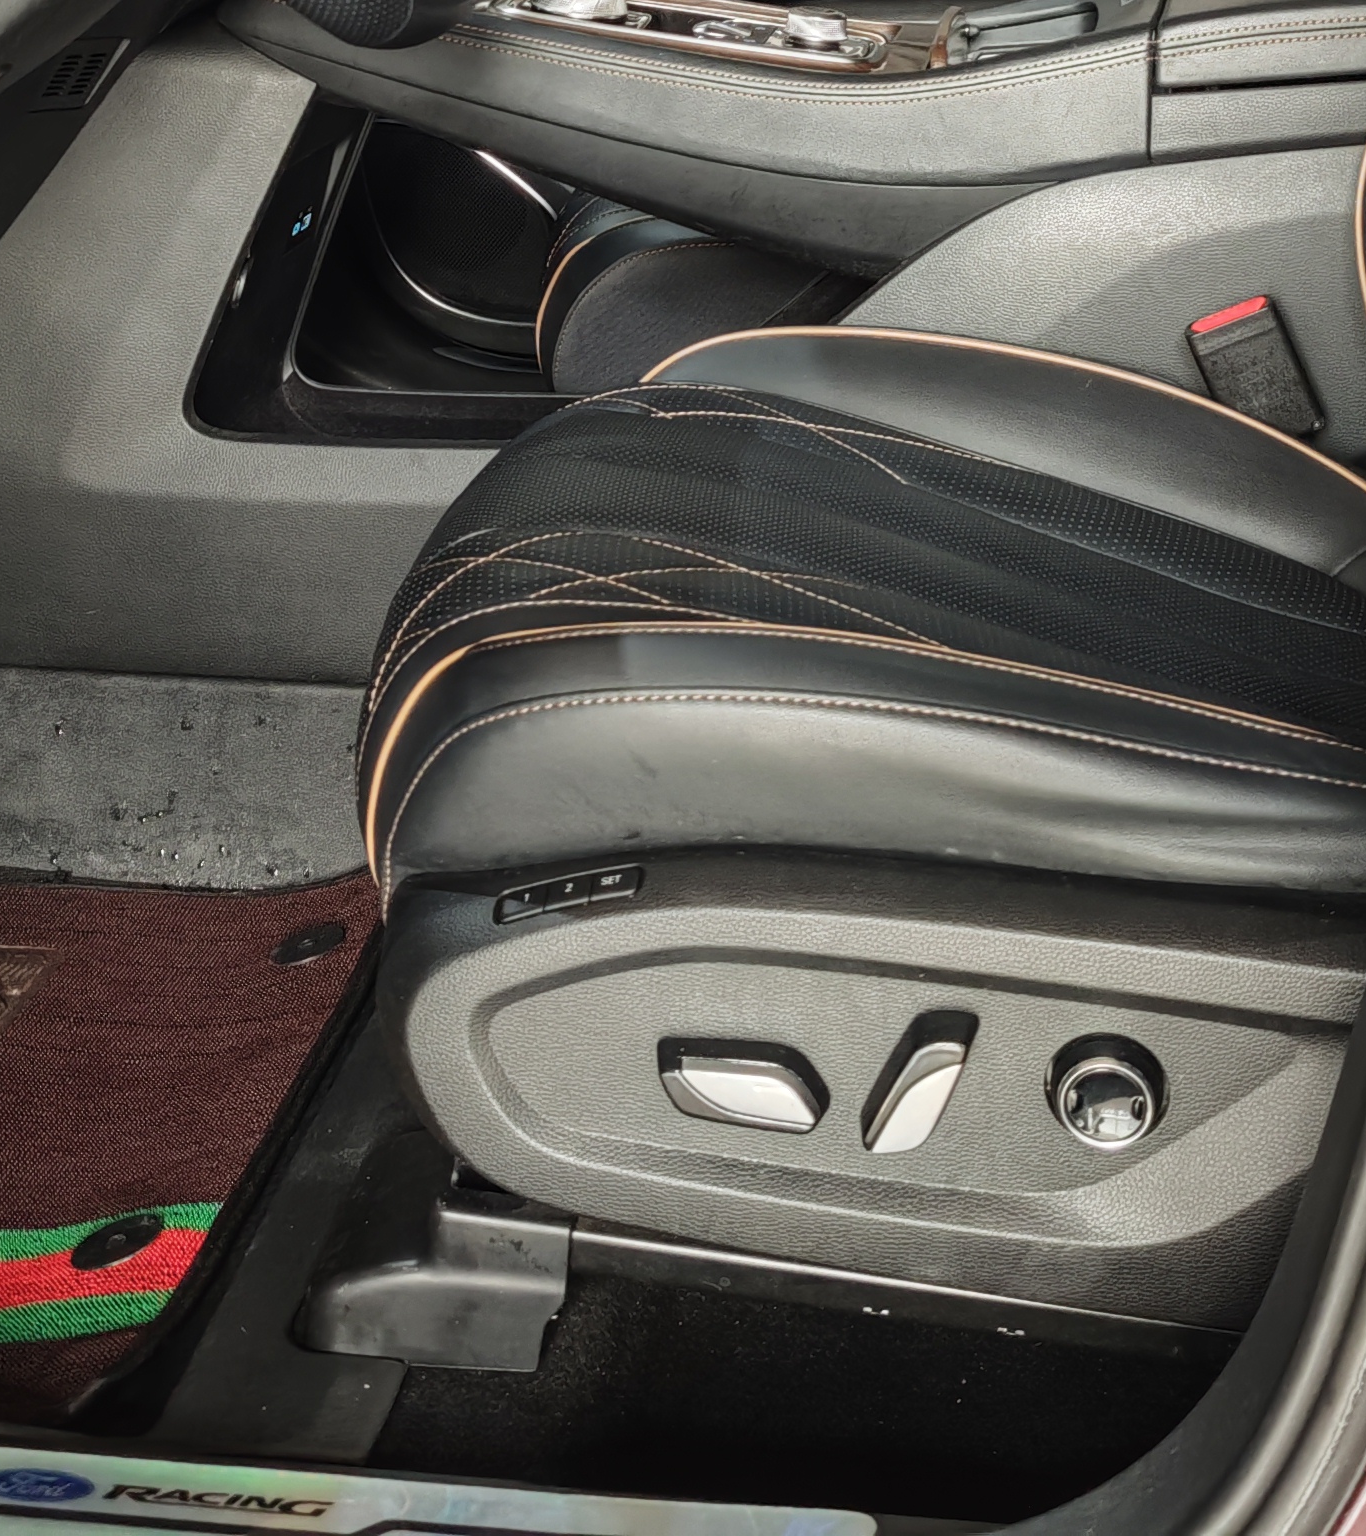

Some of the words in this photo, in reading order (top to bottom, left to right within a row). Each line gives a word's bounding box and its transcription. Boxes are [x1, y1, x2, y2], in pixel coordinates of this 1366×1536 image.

[564, 882, 574, 893] 2
[600, 874, 623, 886] SET
[102, 1484, 335, 1517] RACING
